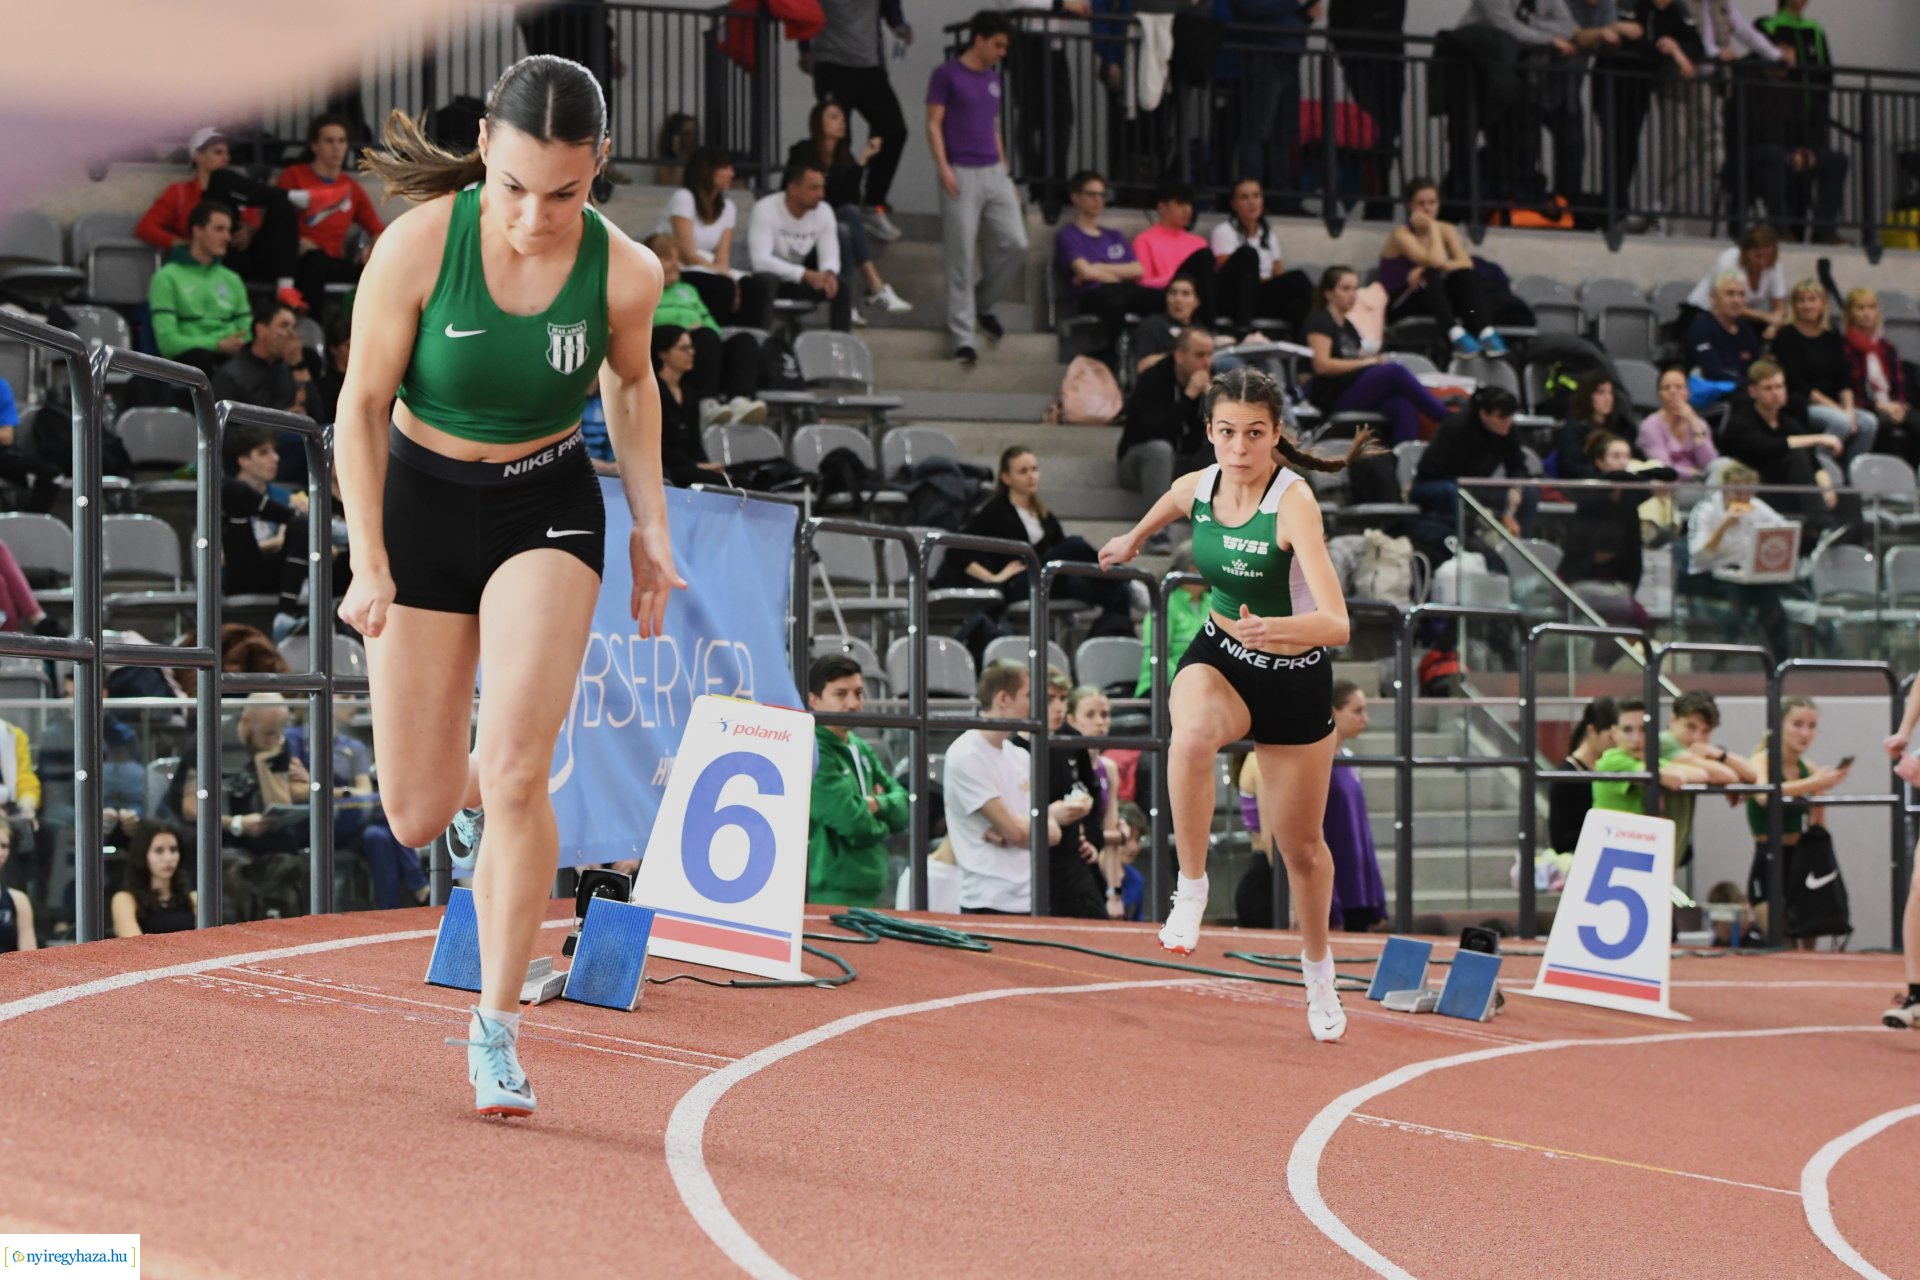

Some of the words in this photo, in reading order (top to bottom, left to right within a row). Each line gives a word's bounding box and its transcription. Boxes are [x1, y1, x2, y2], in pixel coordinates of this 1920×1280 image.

[503, 449, 555, 478] NIKE
[1221, 565, 1263, 577] VESZPRÉM
[1220, 638, 1271, 669] NIKE
[1272, 651, 1321, 670] PRO
[732, 723, 793, 743] polanik
[681, 752, 785, 905] 6
[1577, 847, 1655, 961] 5
